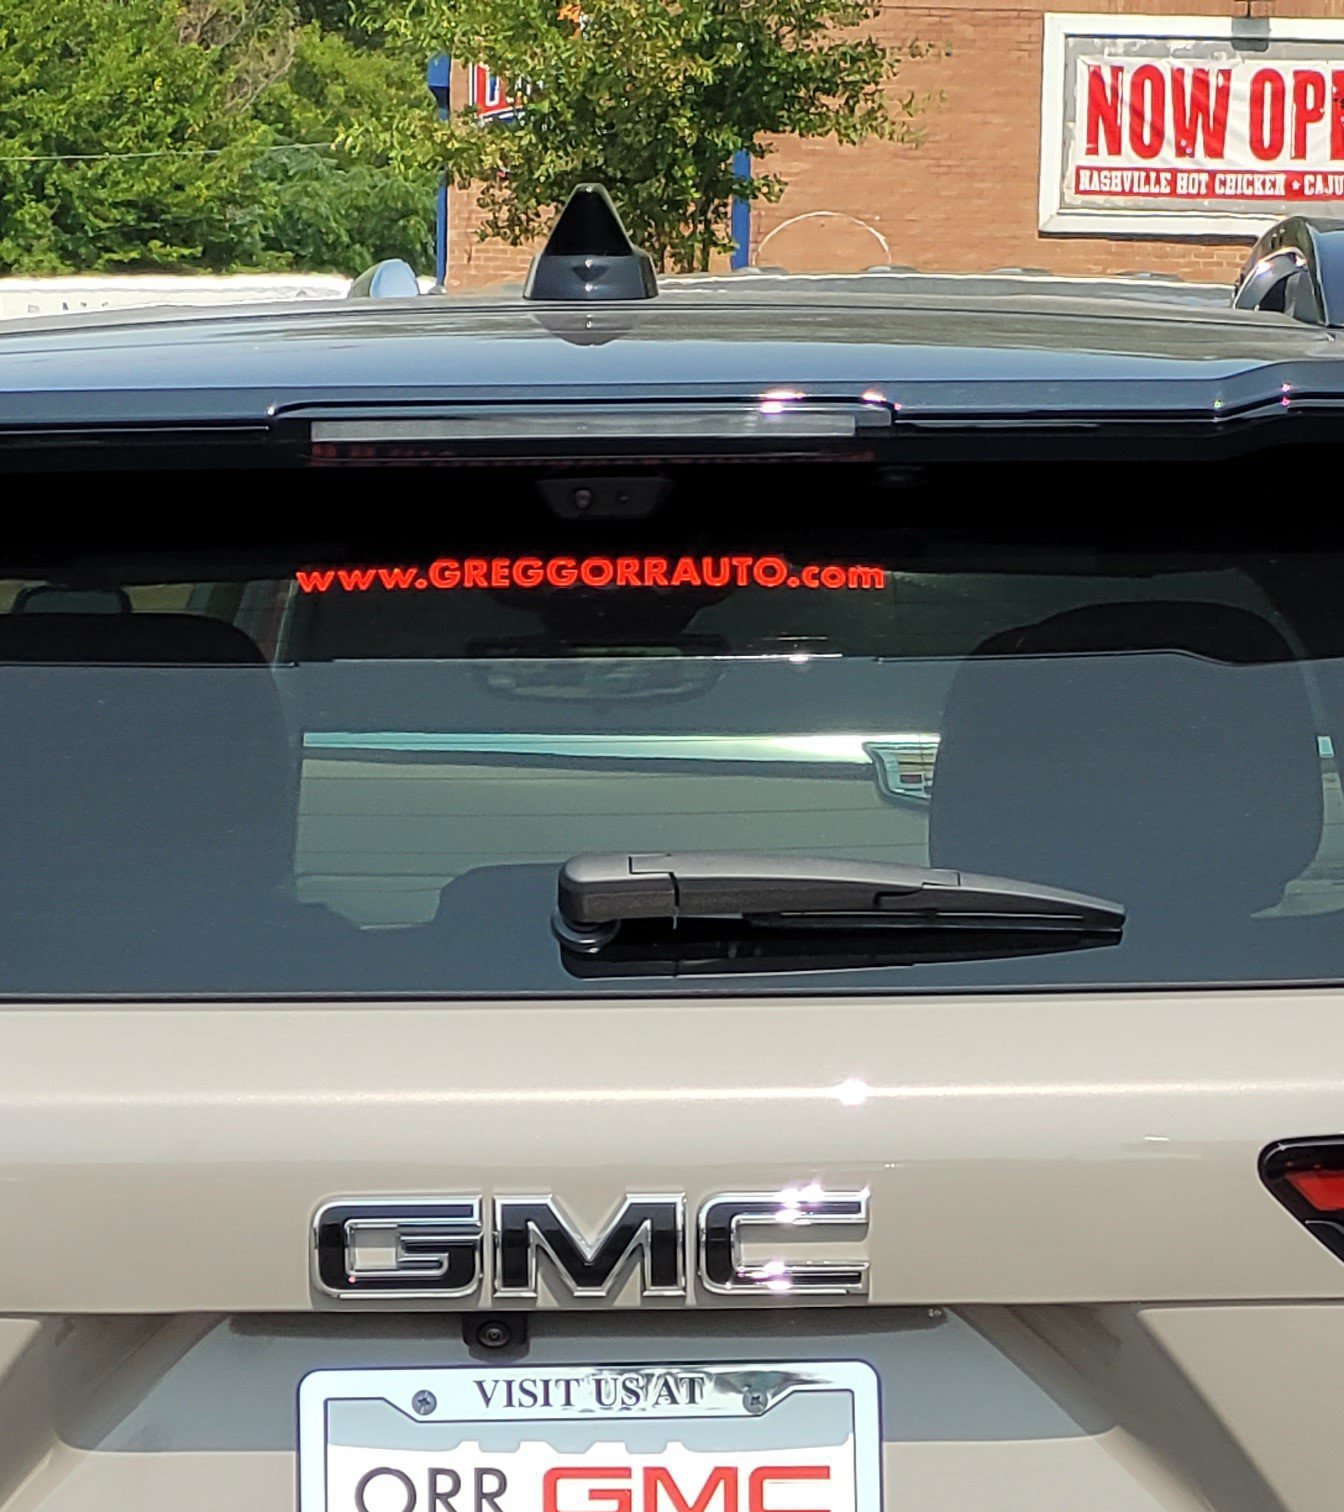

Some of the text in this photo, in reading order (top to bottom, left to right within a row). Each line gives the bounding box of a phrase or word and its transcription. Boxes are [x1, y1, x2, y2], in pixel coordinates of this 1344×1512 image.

[1085, 64, 1232, 159] NOW
[1079, 170, 1171, 194] NASHVILLE
[1176, 172, 1209, 194] HOT
[1214, 172, 1286, 196] CHICKEN
[296, 556, 885, 593] www.GREGGORRAUTO.com
[313, 1192, 870, 1298] GMC
[474, 1376, 706, 1409] VISIT US AT
